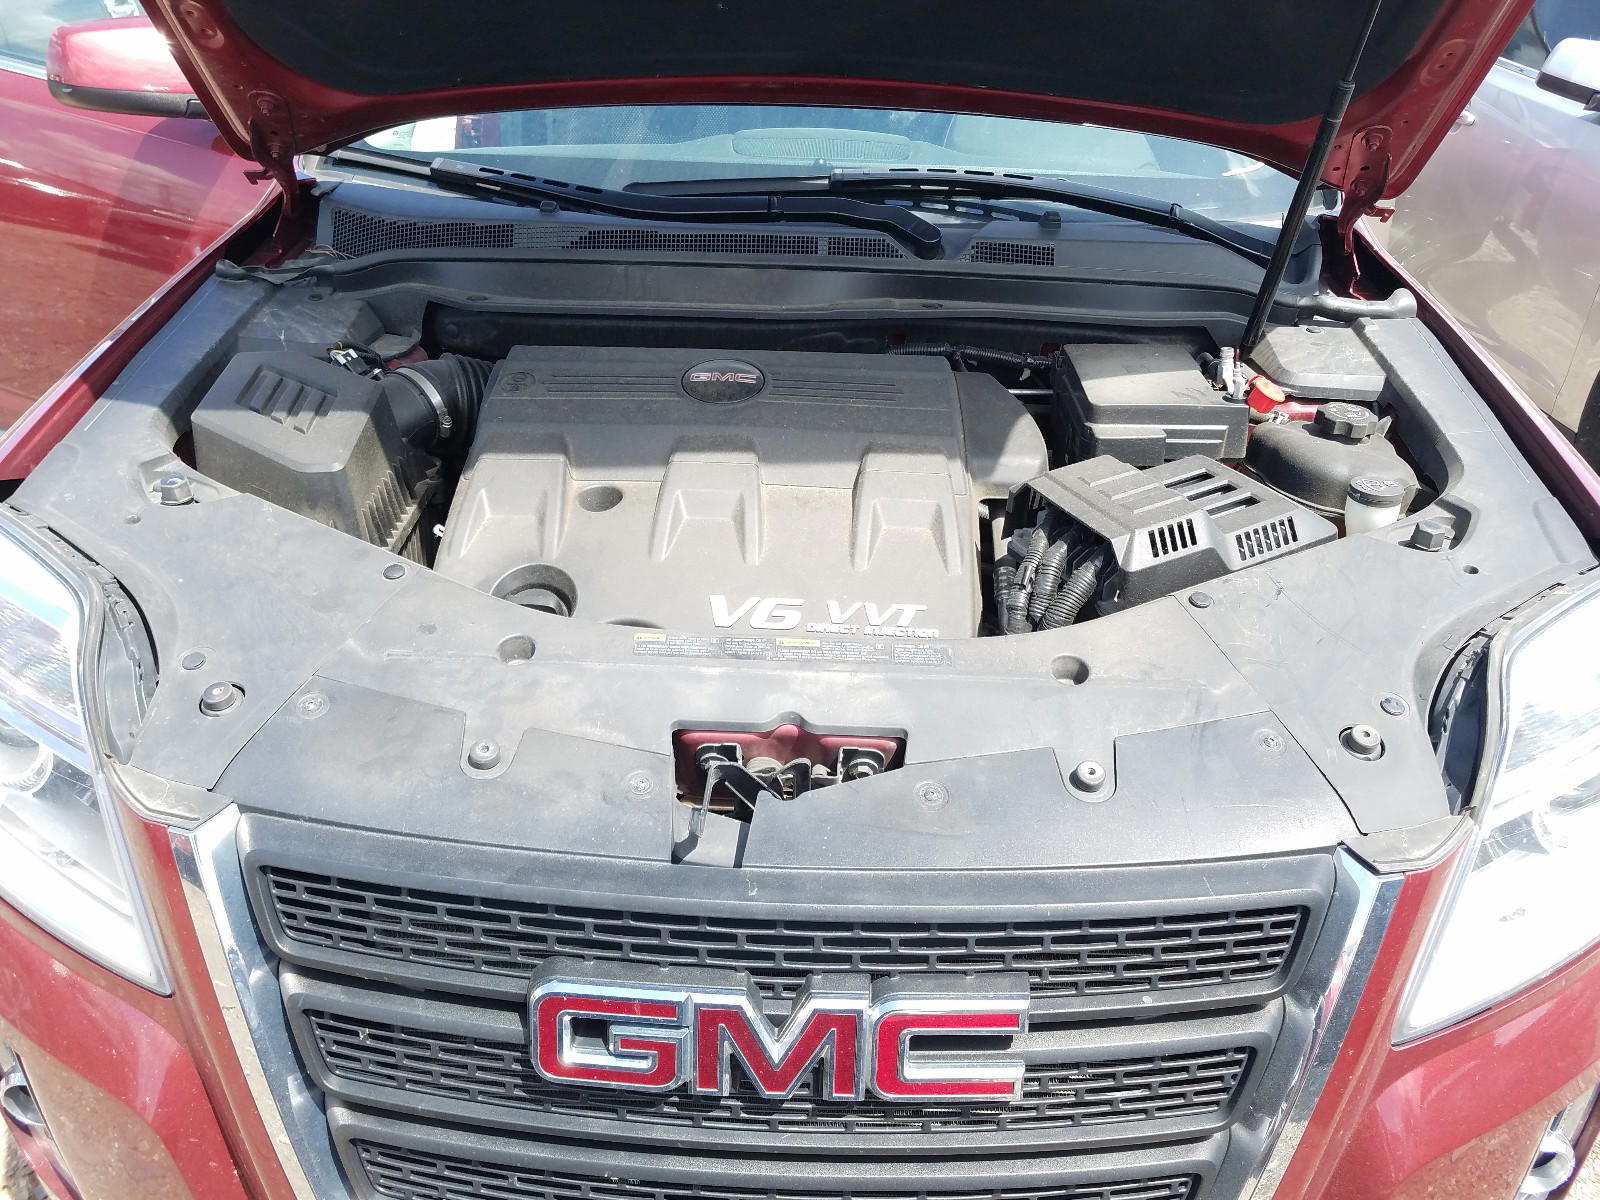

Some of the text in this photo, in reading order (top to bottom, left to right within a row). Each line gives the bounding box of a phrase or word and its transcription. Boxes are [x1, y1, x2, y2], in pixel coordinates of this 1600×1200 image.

[690, 372, 757, 384] GMC
[709, 594, 928, 630] V6 VVT
[806, 622, 860, 635] DIRECT
[529, 971, 1030, 1102] GMC
